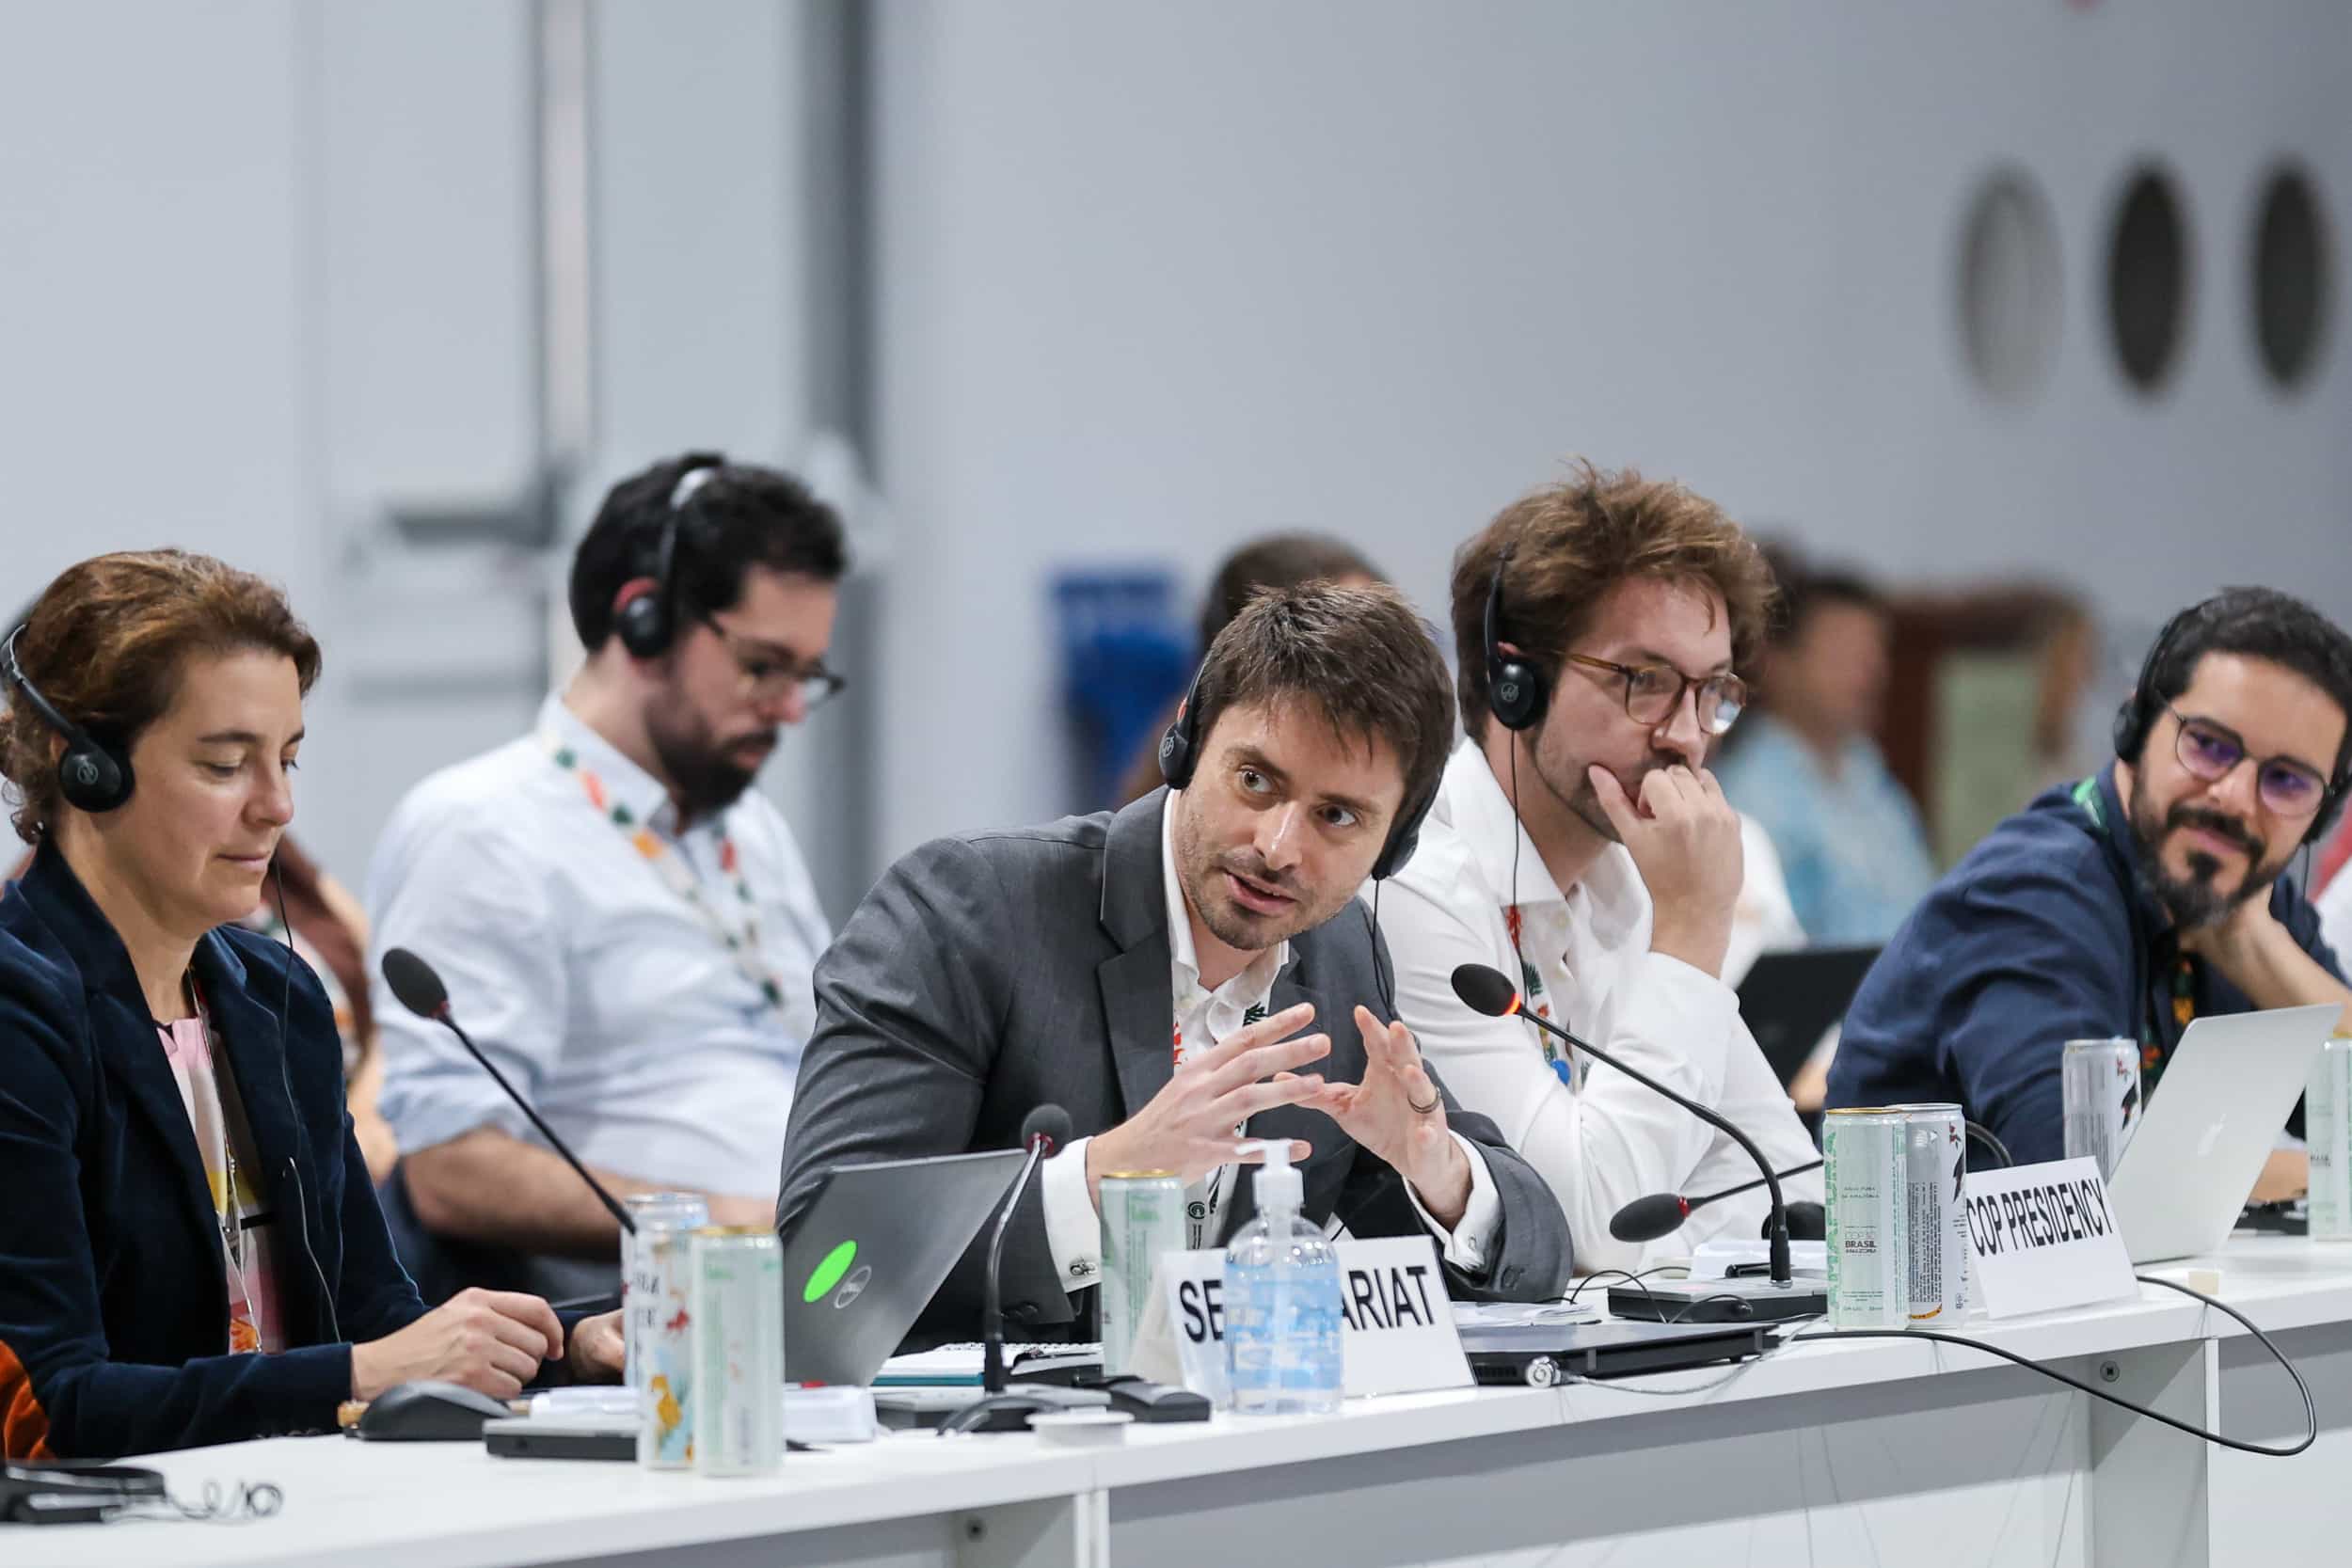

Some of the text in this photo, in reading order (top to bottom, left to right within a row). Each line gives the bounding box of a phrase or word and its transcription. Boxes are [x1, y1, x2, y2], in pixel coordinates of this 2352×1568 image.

[1845, 1240, 1877, 1248] BRASIL
[1965, 1195, 2004, 1257] COP
[2000, 1178, 2112, 1250] PRESIDENCY
[1180, 1266, 1434, 1343] SERIAT
